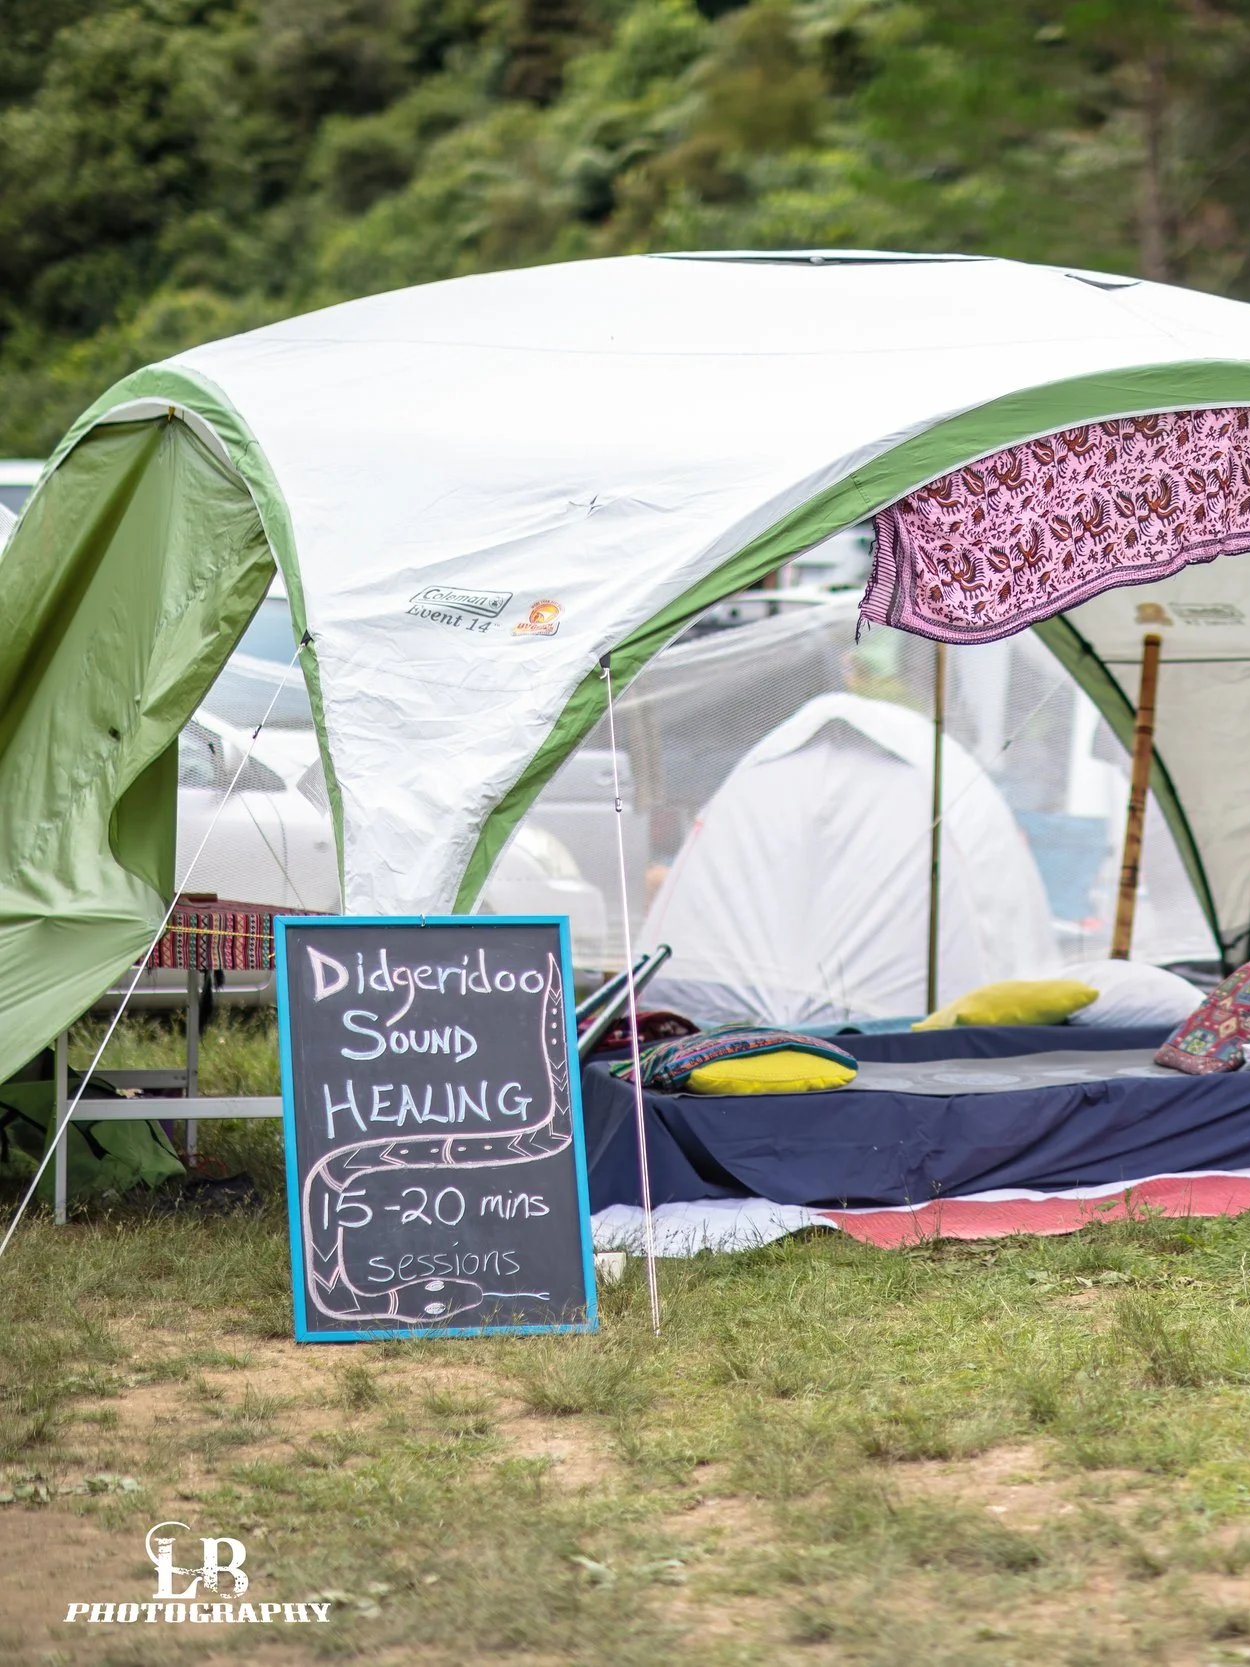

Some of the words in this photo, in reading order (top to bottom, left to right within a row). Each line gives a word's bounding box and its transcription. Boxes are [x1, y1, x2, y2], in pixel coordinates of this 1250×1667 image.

[422, 588, 487, 606] Coleman
[405, 604, 463, 628] Event
[465, 617, 492, 633] 14
[306, 945, 545, 1027] Didgeridoo
[323, 1079, 533, 1139] HEALING
[480, 1192, 551, 1220] mins
[368, 1240, 521, 1282] sessions
